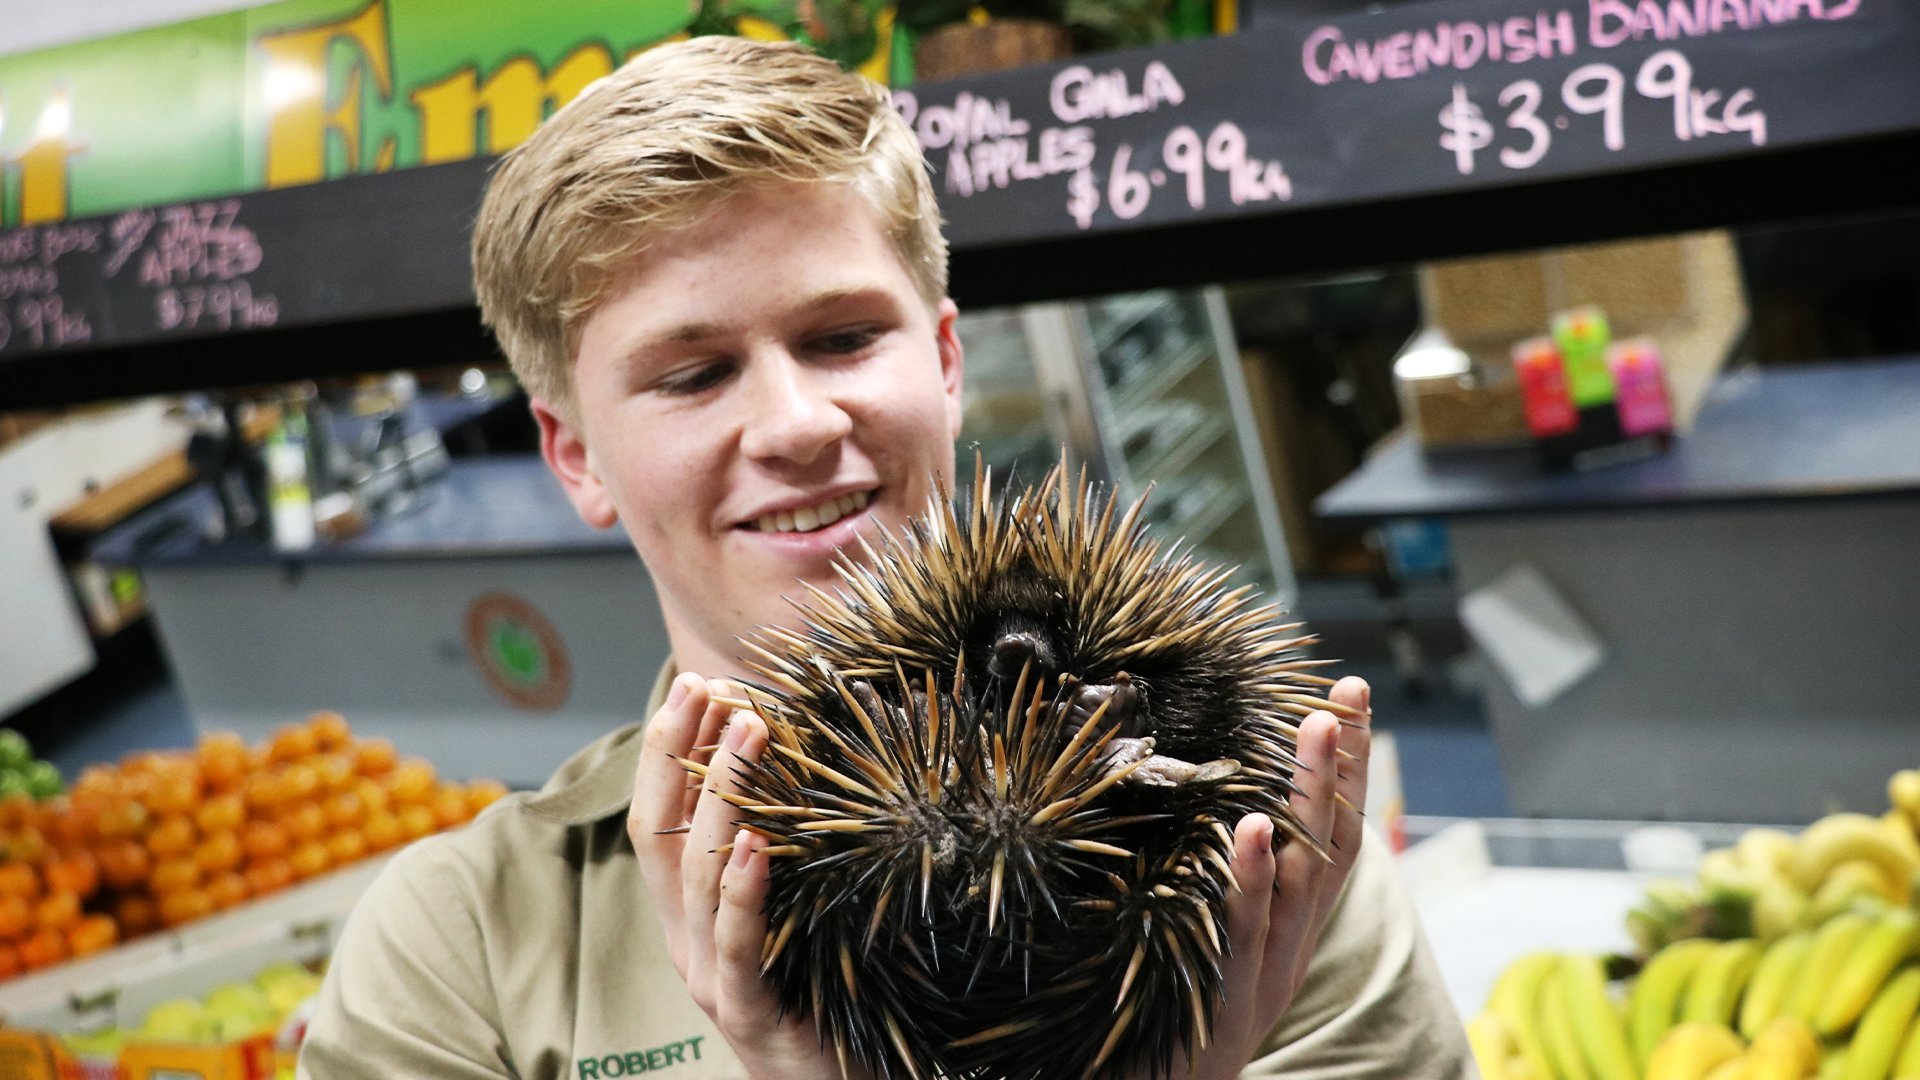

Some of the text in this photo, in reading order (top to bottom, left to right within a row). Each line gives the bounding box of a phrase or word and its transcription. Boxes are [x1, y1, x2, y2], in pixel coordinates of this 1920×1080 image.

[1301, 10, 1576, 84] CAVENDISH
[254, 0, 690, 190] Em
[1049, 60, 1185, 123] GALA
[944, 126, 1096, 198] APPLES
[577, 1035, 705, 1080] ROBERT
